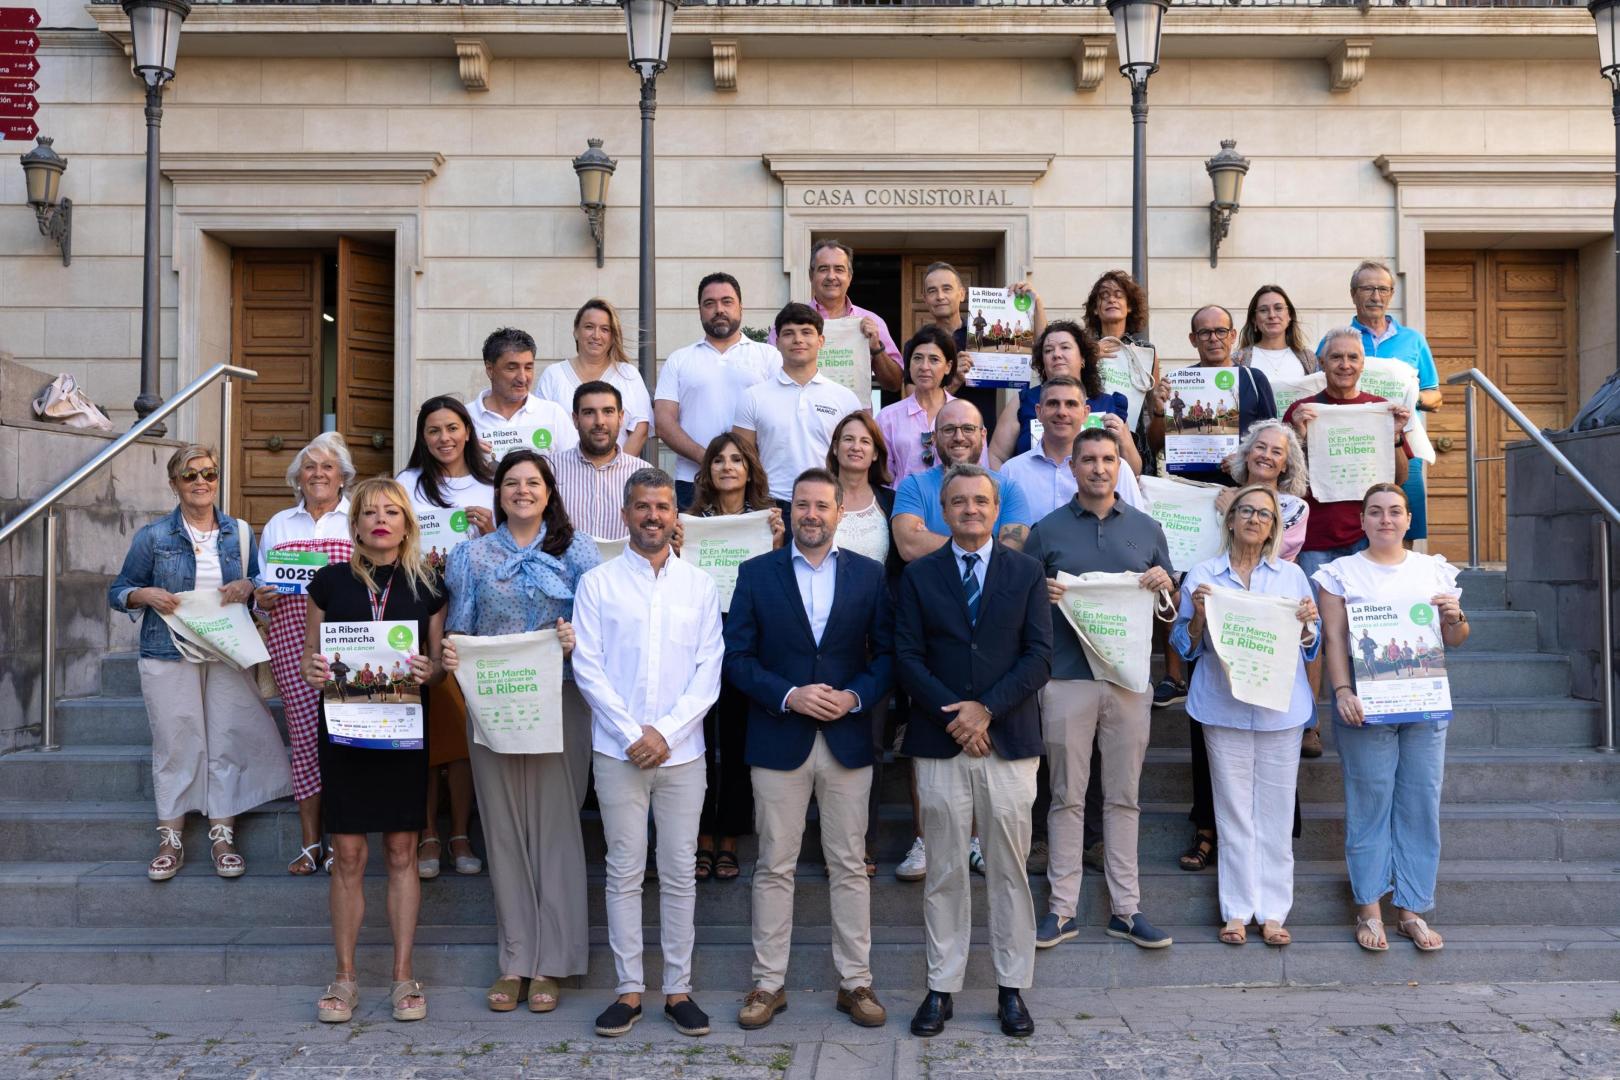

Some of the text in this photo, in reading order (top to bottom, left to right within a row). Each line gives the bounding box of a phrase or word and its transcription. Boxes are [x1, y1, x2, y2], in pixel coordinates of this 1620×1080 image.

[803, 189, 1014, 206] CASA CONSISTORIAL
[825, 359, 854, 368] Ribera
[1329, 446, 1376, 456] La Ribera
[1166, 522, 1200, 532] Ribera
[1096, 612, 1127, 622] Marcha
[339, 625, 369, 634] Ribera
[1089, 624, 1126, 636] Ribera
[1233, 624, 1244, 632] En
[1246, 627, 1277, 640] Marcha
[339, 635, 375, 643] marcha
[1220, 634, 1274, 656] La Ribera
[477, 668, 537, 679] IX En Marcha
[478, 682, 538, 695] La Ribera
